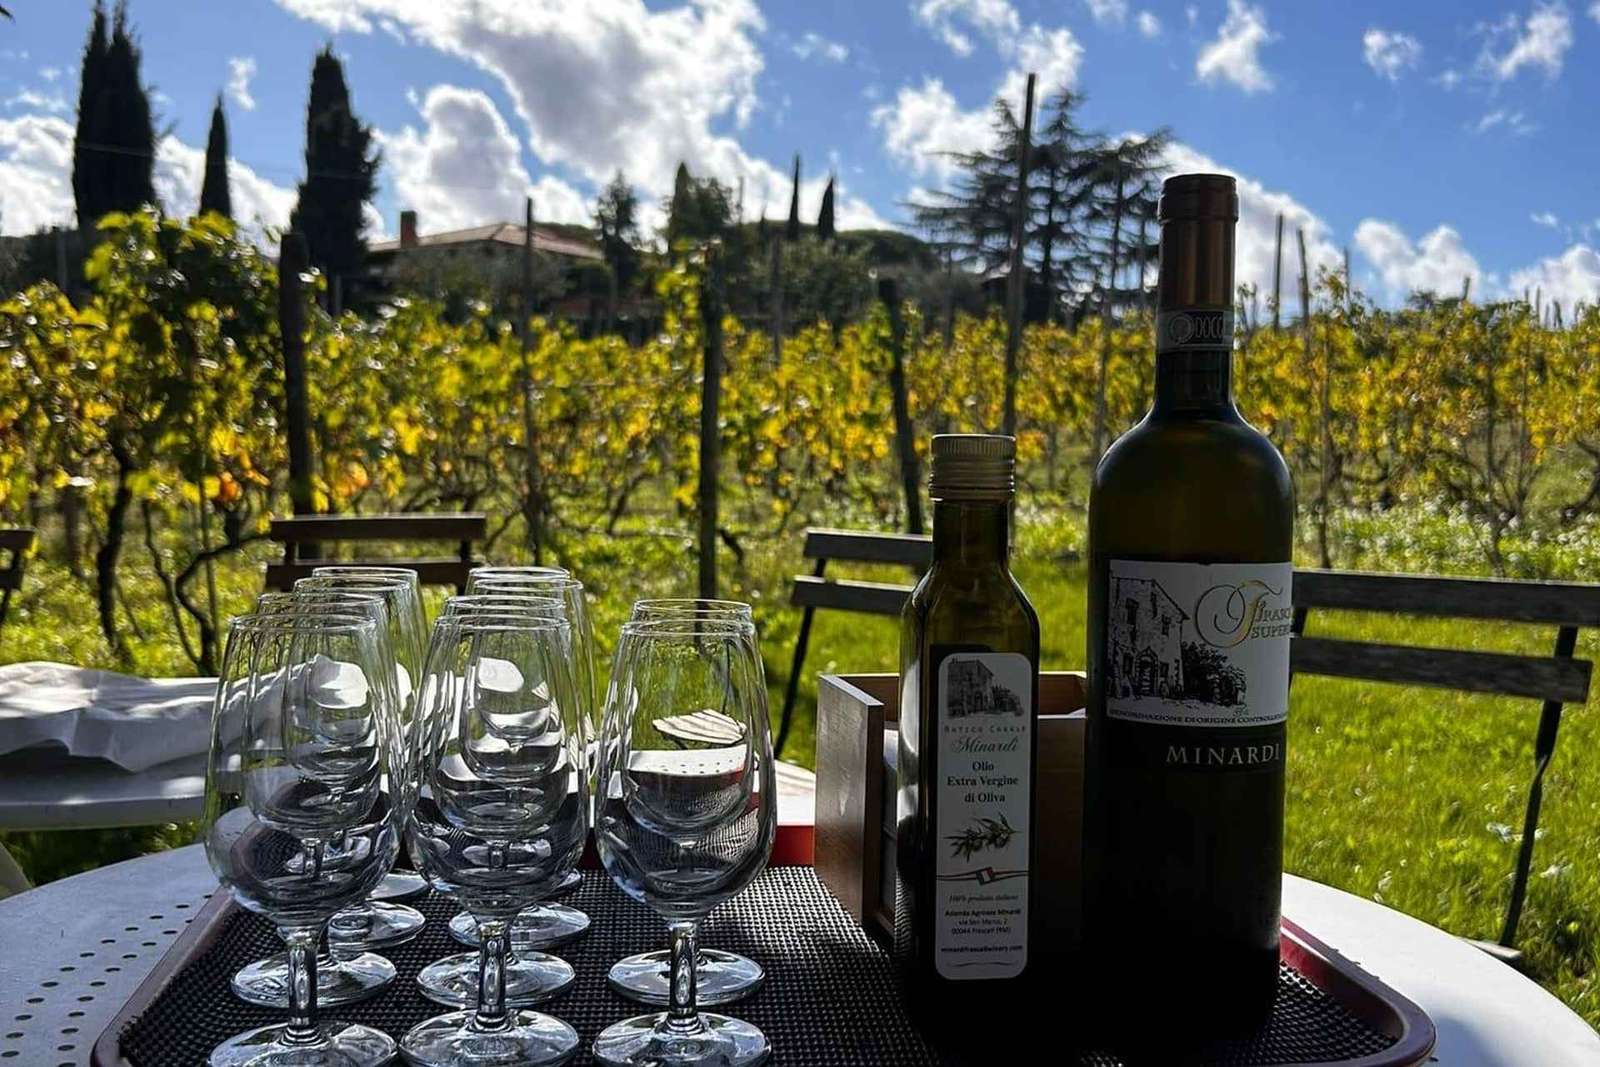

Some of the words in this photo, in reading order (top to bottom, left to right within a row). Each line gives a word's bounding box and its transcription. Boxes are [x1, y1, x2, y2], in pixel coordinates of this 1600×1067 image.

[952, 735, 1018, 752] Minardi
[1166, 743, 1280, 765] MINARDI
[972, 760, 994, 771] Olio
[947, 775, 977, 786] Extra
[979, 775, 1018, 788] Vergine
[964, 793, 975, 802] di
[978, 793, 1005, 802] Oliva
